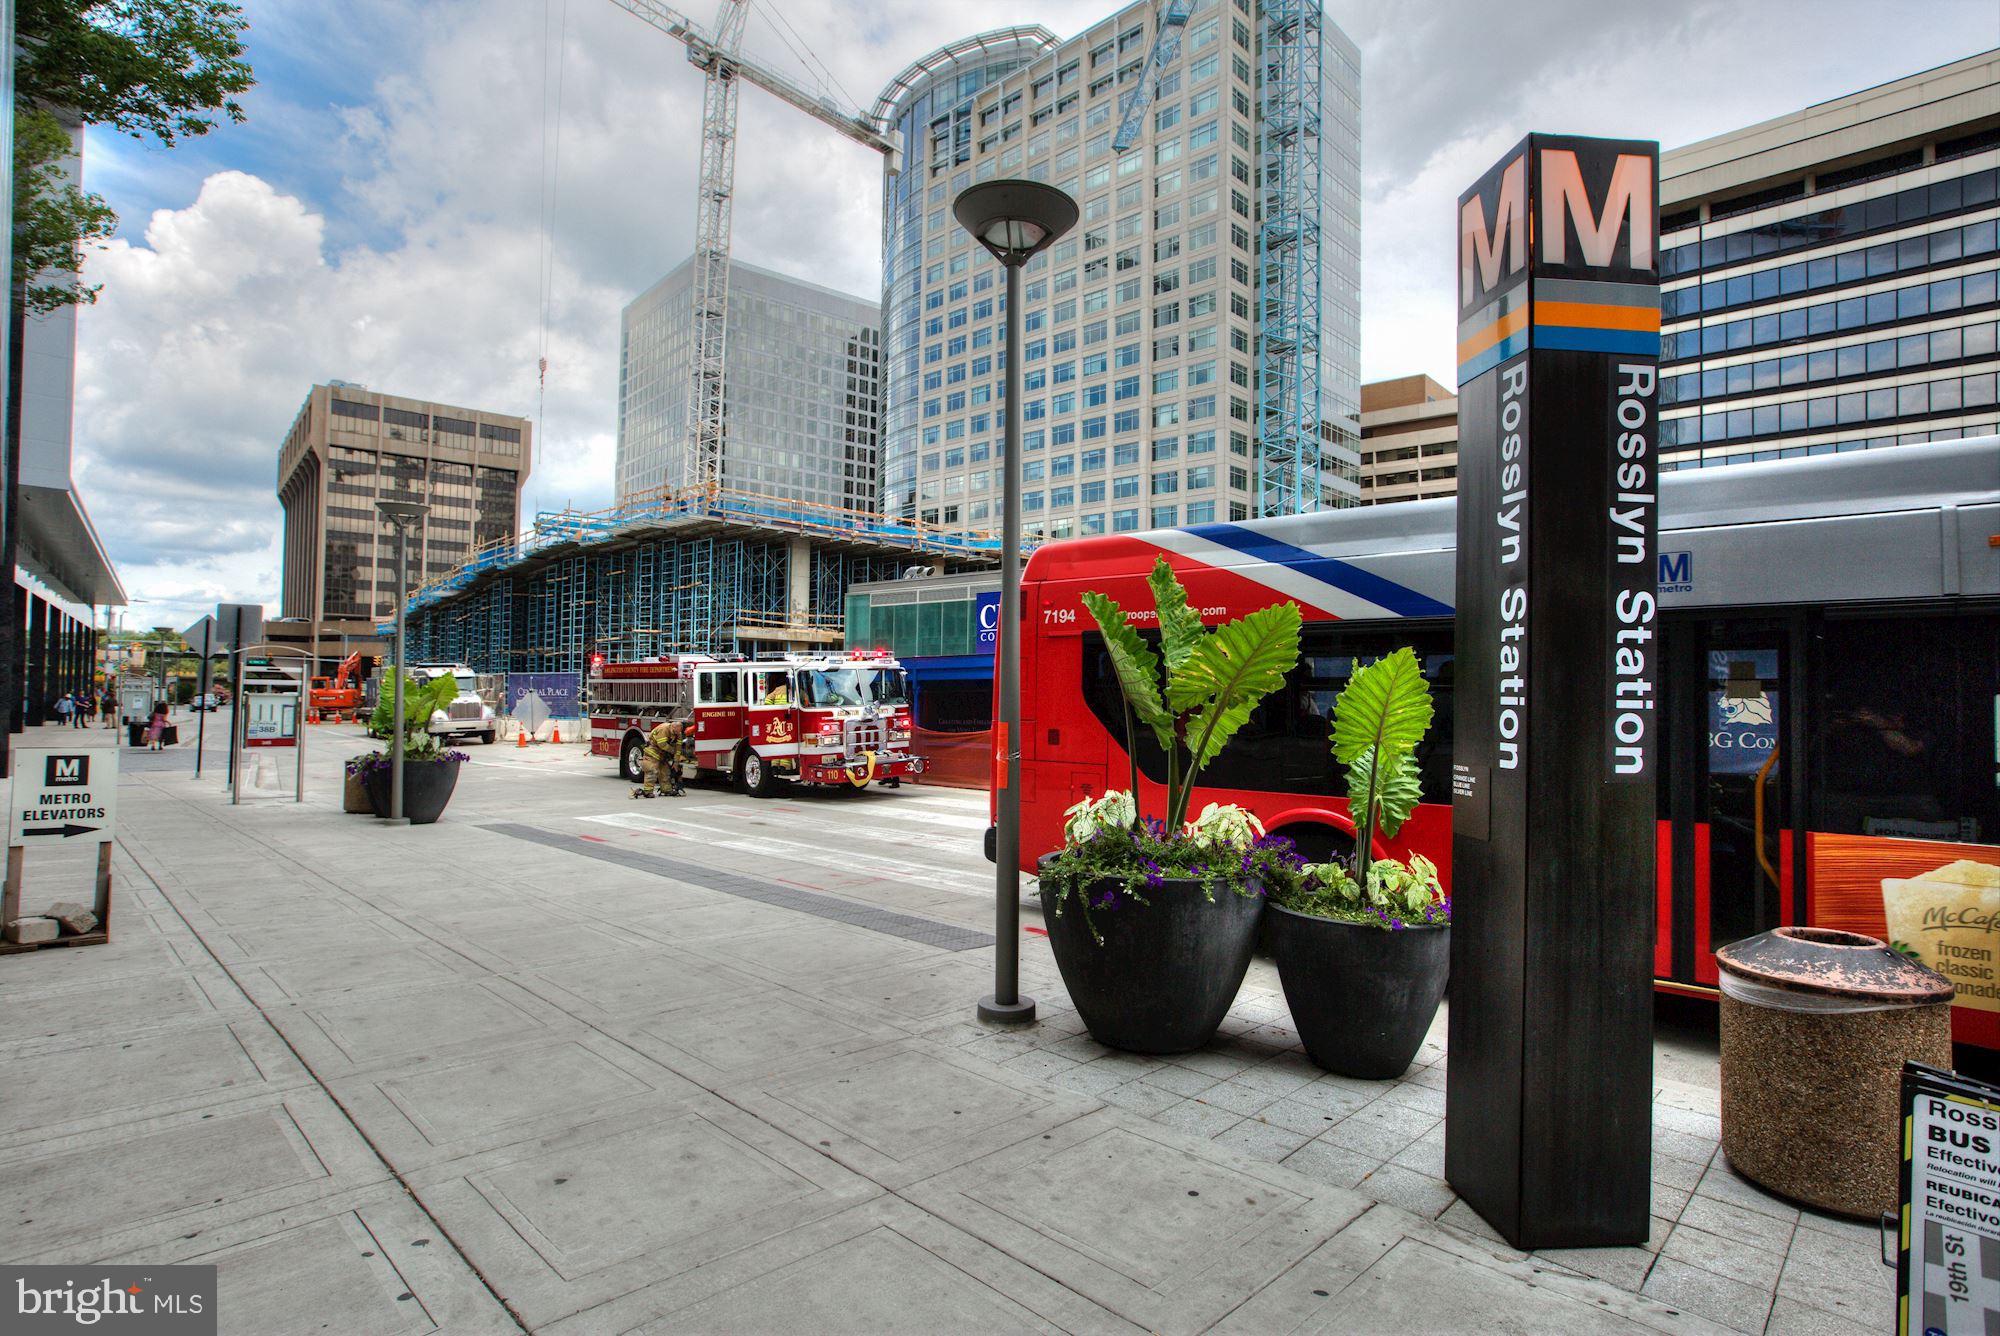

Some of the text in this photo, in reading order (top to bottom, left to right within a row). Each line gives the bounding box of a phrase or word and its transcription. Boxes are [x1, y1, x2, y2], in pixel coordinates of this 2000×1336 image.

[1541, 149, 1653, 271] M
[1461, 154, 1525, 309] M
[1497, 360, 1527, 770] Rosslyn Station
[1609, 364, 1656, 774] Rosslyn Station
[1659, 554, 1689, 582] M
[1044, 609, 1076, 624] 7194
[547, 687, 569, 697] PLACE
[55, 758, 80, 777] M
[827, 770, 839, 780] 110
[40, 793, 92, 805] METRO
[23, 808, 105, 821] ELEVATORS
[1937, 940, 1991, 961] frozen
[1936, 959, 1994, 980] classic
[1928, 1124, 1991, 1154] BUS
[1927, 1162, 1977, 1181] Relocation
[1979, 1178, 1997, 1187] will
[1926, 1195, 2000, 1226] Efectivo
[1944, 1234, 1970, 1303] 19th St
